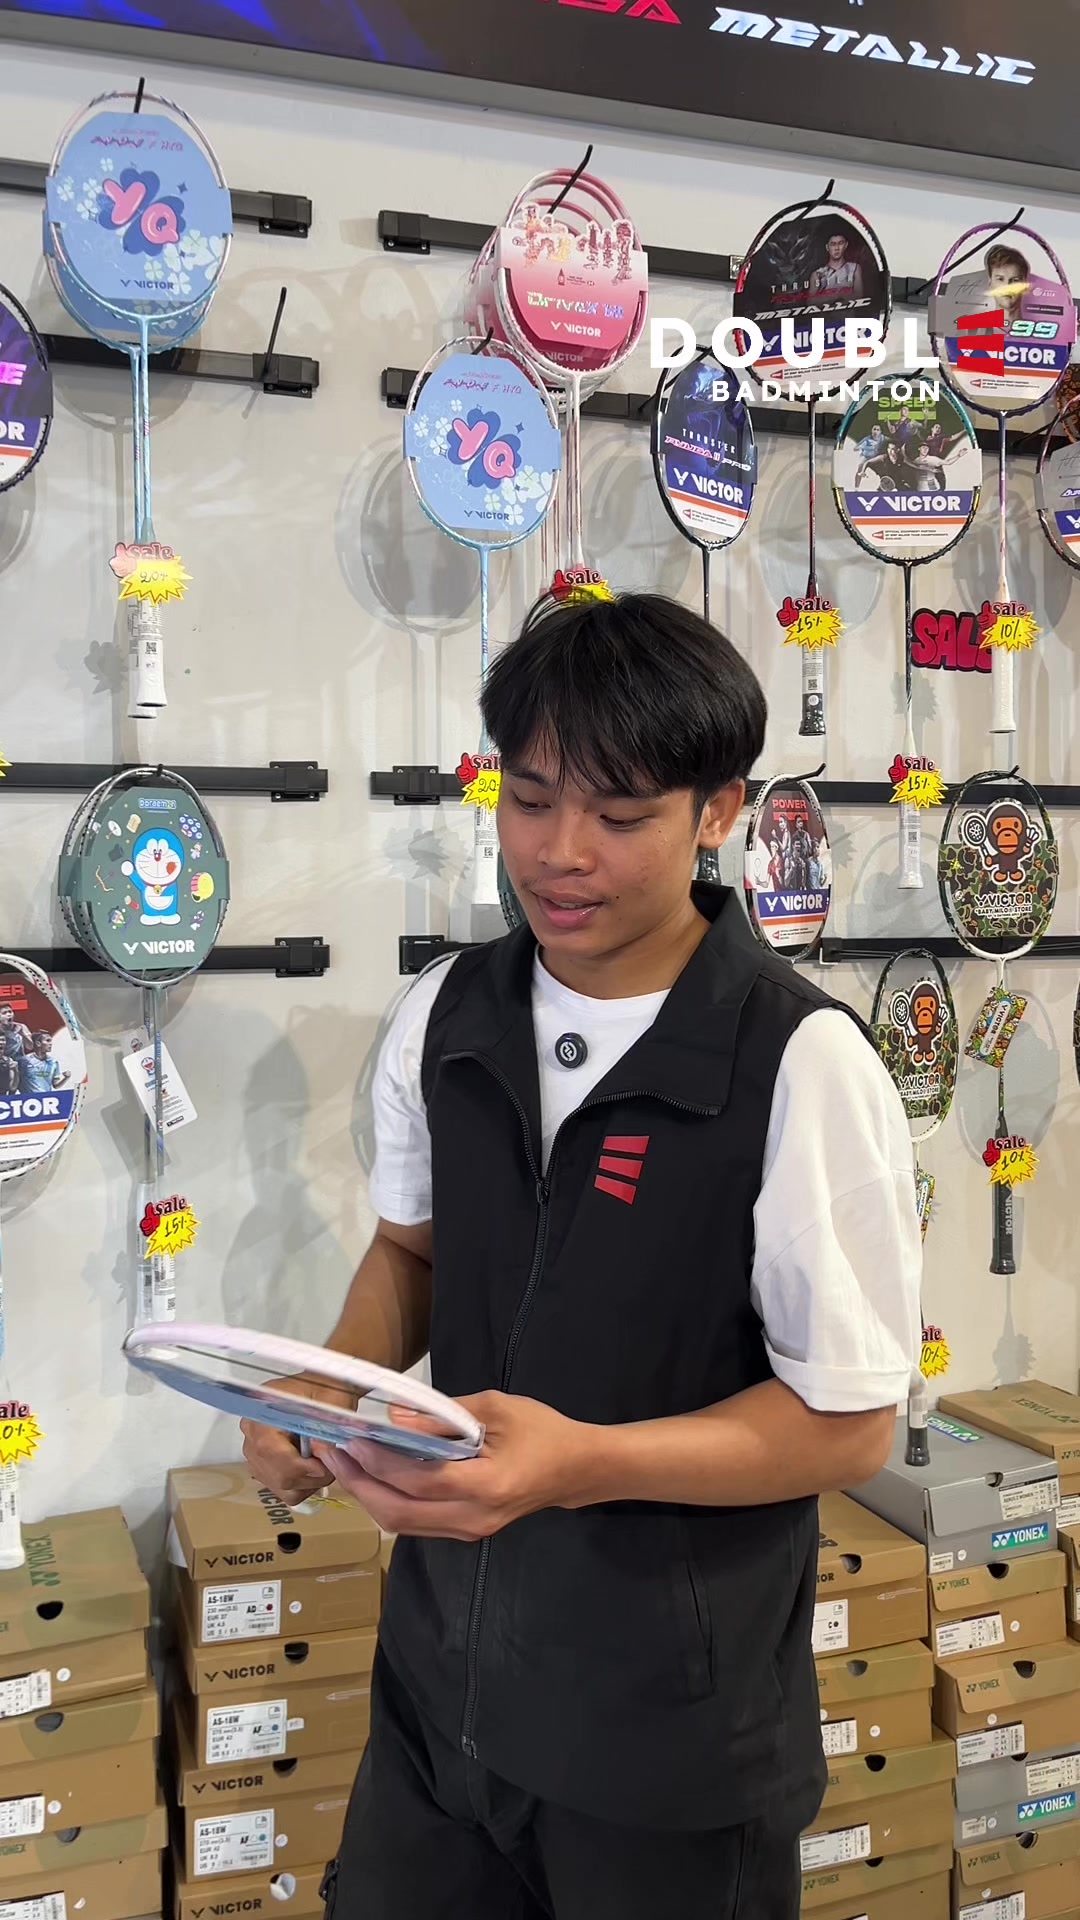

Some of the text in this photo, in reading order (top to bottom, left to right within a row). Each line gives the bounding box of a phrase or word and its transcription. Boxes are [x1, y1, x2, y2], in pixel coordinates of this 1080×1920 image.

[709, 6, 1036, 85] METALLIC
[134, 279, 174, 290] VICTOR
[753, 297, 872, 321] METALLIC
[563, 322, 601, 338] VICTOR
[682, 428, 736, 454] THRUSTER
[691, 473, 744, 505] VICTOR
[883, 496, 961, 512] VICTOR
[475, 510, 510, 521] VICTOR
[128, 544, 173, 560] sale
[565, 569, 600, 584] sale
[794, 597, 831, 611] sale
[992, 601, 1026, 617] sale
[473, 756, 501, 770] sal
[904, 757, 934, 771] sale
[772, 798, 807, 809] POWER
[780, 893, 823, 911] VICTOR
[988, 892, 1032, 906] VICTOR
[141, 939, 196, 955] VICTOR
[909, 1072, 940, 1088] VICTOR
[995, 1135, 1026, 1150] sale
[155, 1196, 186, 1216] sale
[921, 1326, 942, 1341] ale
[1013, 1525, 1045, 1544] YONEX
[24, 1533, 57, 1570] YONEX
[222, 1551, 275, 1566] VICTOR
[949, 1577, 971, 1588] YONEX
[222, 1663, 275, 1680] VICTOR
[977, 1678, 1000, 1690] YONEX
[211, 1775, 264, 1792] VICTOR
[1039, 1794, 1072, 1814] YONEX
[208, 1898, 263, 1916] VICTOR
